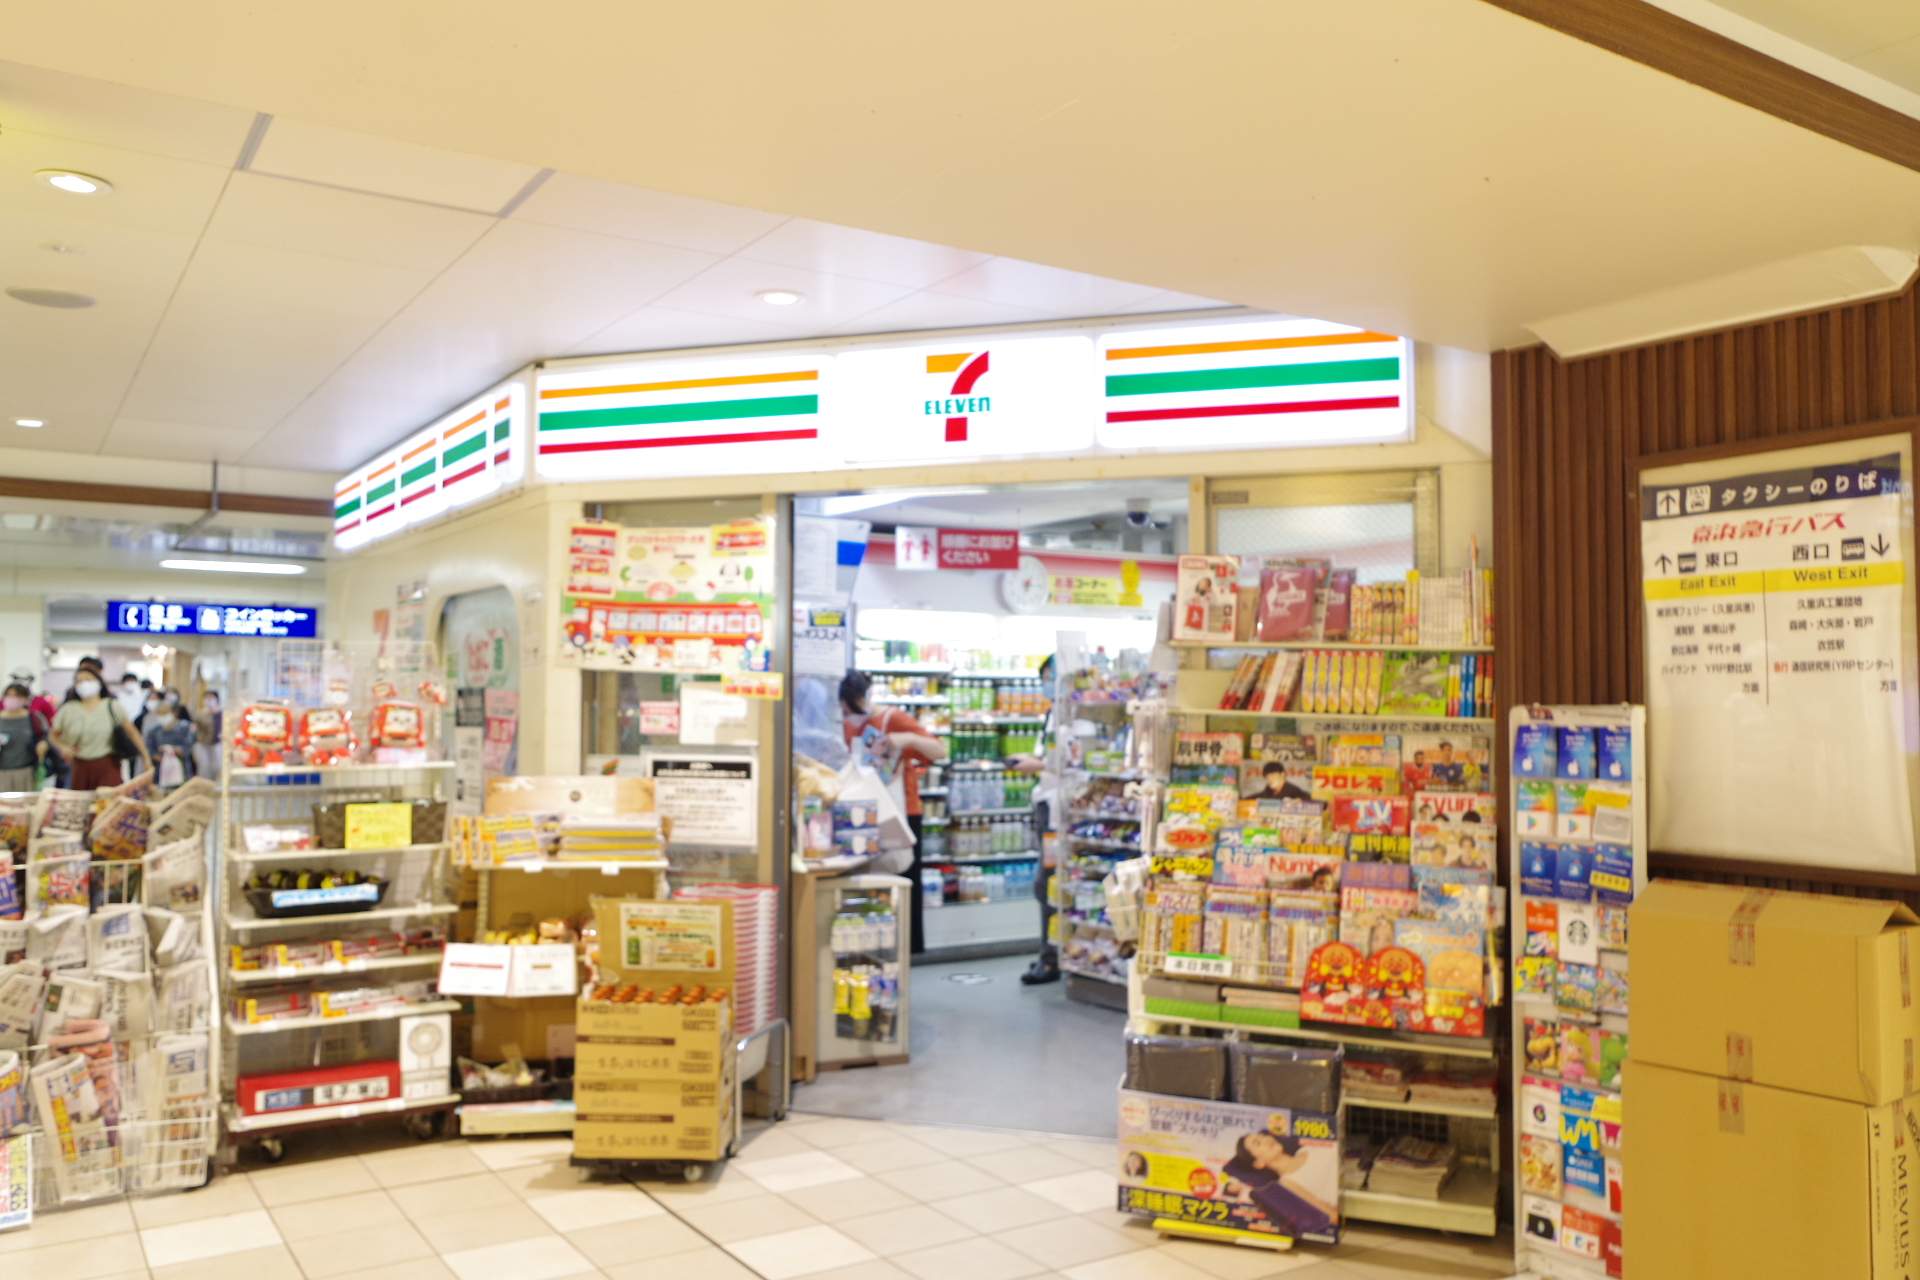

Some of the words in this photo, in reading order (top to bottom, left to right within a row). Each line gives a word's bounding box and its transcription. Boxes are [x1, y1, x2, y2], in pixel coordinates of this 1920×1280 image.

[1721, 471, 1878, 506] タクシーのりば
[1691, 512, 1847, 545] 京浜急行バス
[1705, 551, 1739, 568] 東口
[1792, 543, 1830, 561] 西口
[1680, 578, 1704, 590] East
[1709, 575, 1737, 588] Exit
[1793, 570, 1832, 582] West
[1838, 566, 1868, 581] Exit
[1897, 1154, 1911, 1268] MEVIUS
